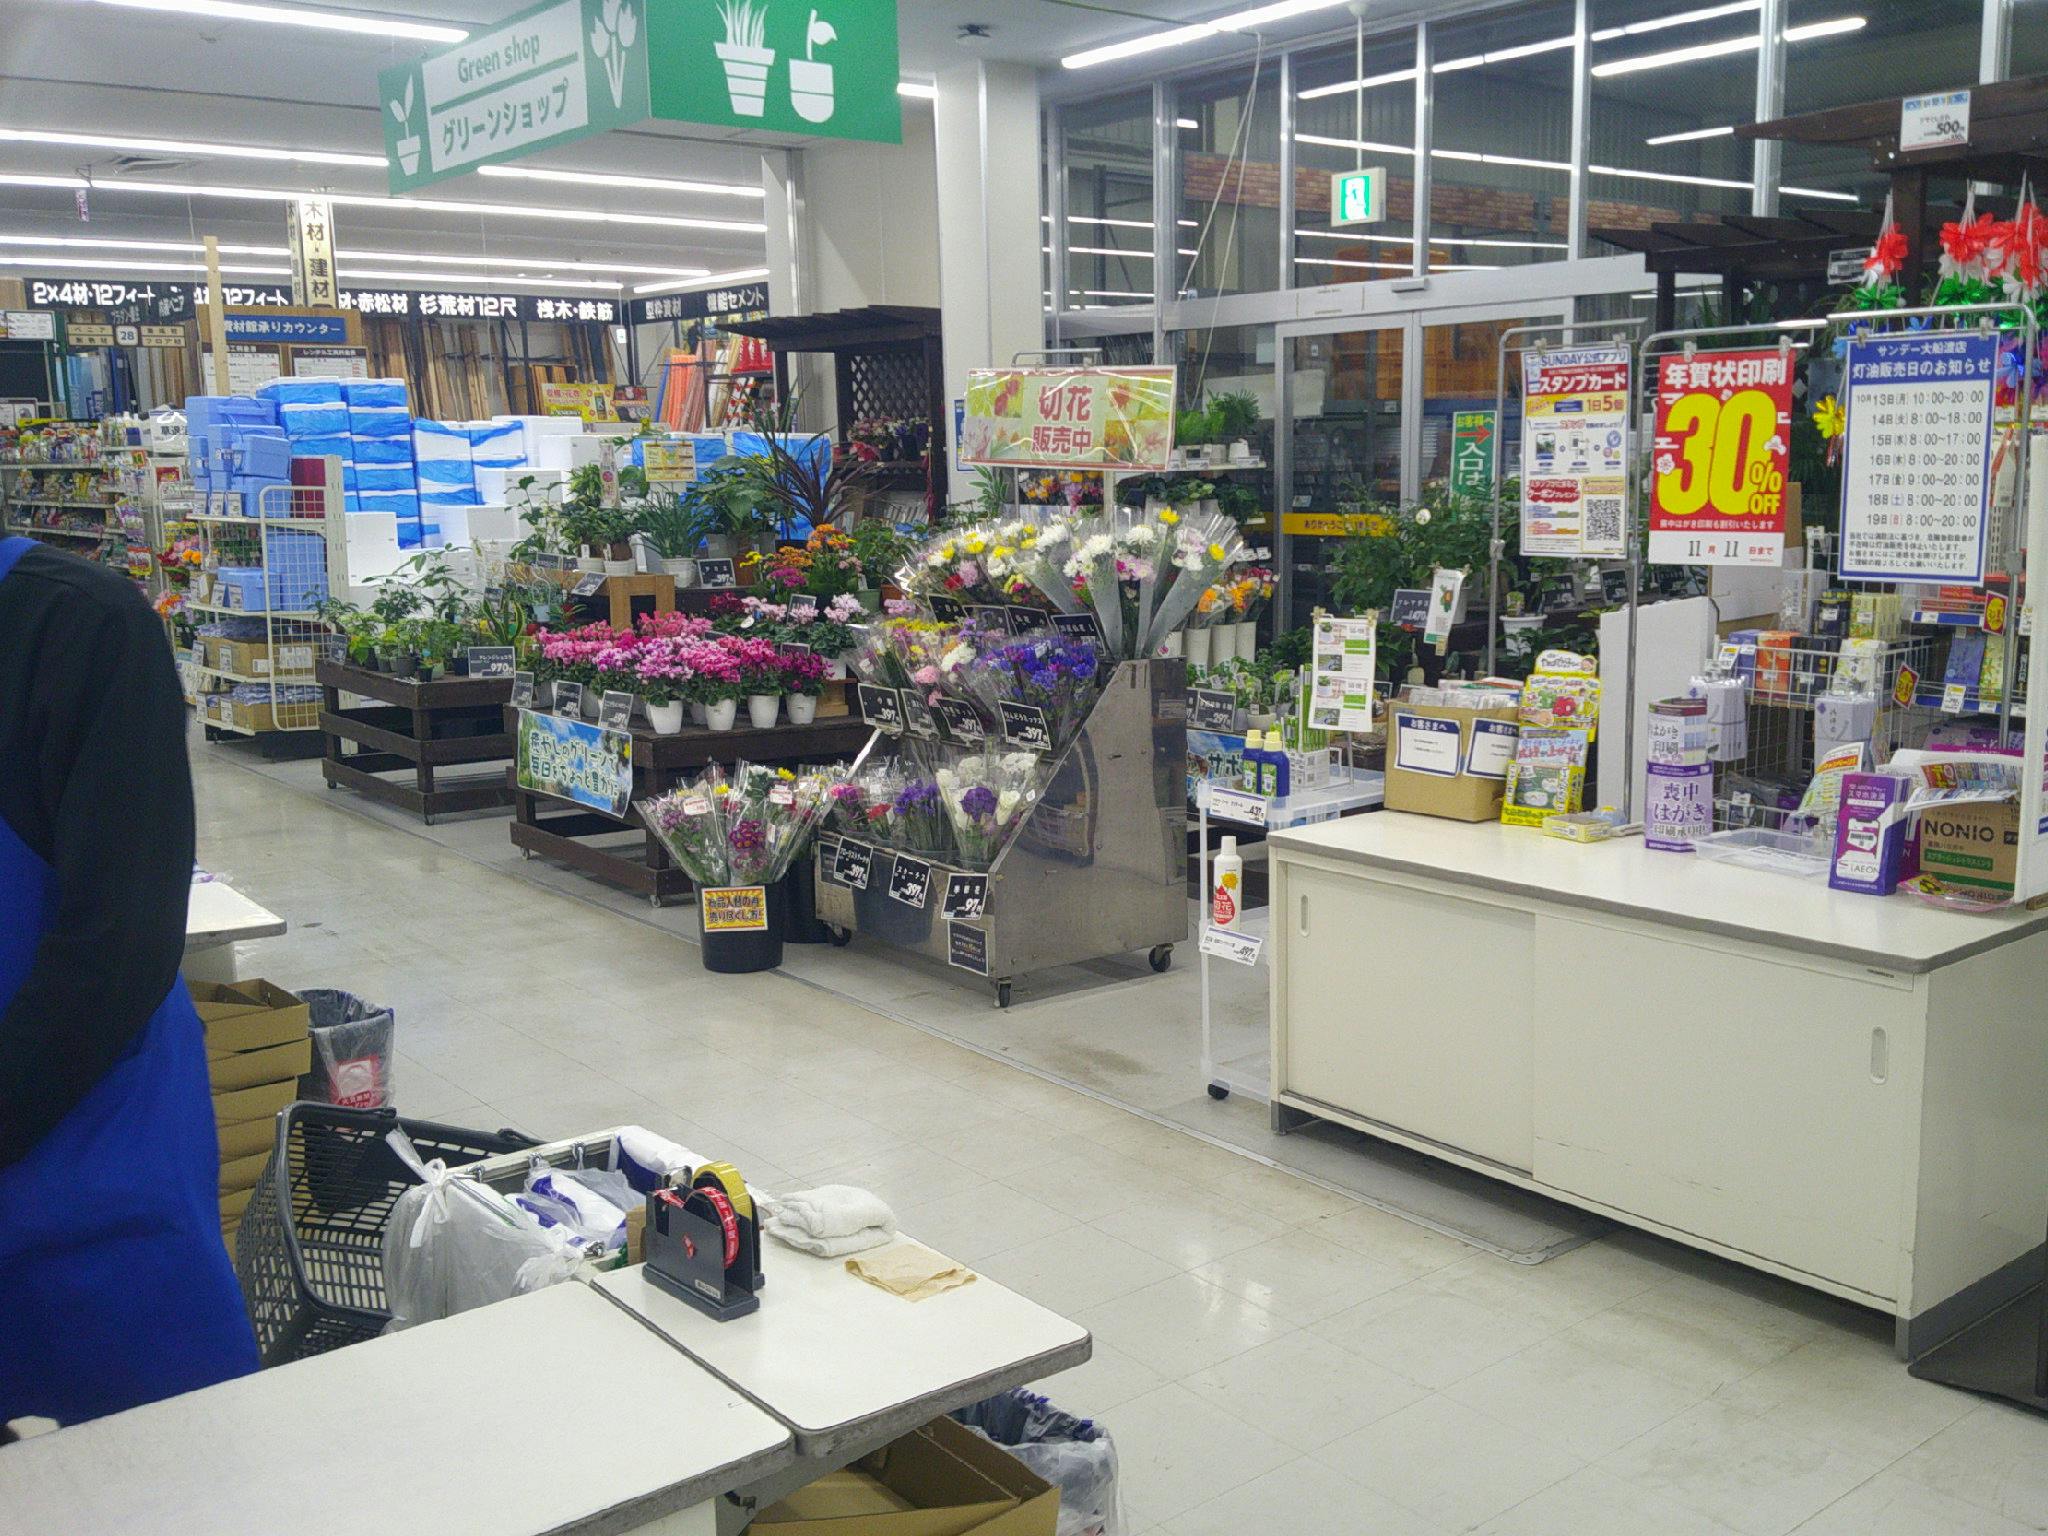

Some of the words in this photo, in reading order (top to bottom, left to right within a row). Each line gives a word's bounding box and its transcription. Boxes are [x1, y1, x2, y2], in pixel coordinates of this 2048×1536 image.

[458, 41, 501, 84] Green
[504, 33, 540, 71] shop
[443, 77, 569, 156] グリーンショップ
[120, 331, 135, 341] 28
[1664, 357, 1788, 390] 年賀状印刷
[1853, 358, 1992, 379] 灯油販売日のお知らせ
[1540, 371, 1627, 393] スタンプカード
[1037, 384, 1094, 423] 切花
[1031, 425, 1093, 456] 販売中
[1749, 493, 1782, 516] OFF
[1687, 540, 1702, 558] 11
[1723, 540, 1740, 558] 11
[1410, 720, 1448, 732] お客さまへ
[1663, 782, 1700, 802] 喪中
[1653, 802, 1707, 823] はがき
[1925, 819, 1995, 842] NONIO
